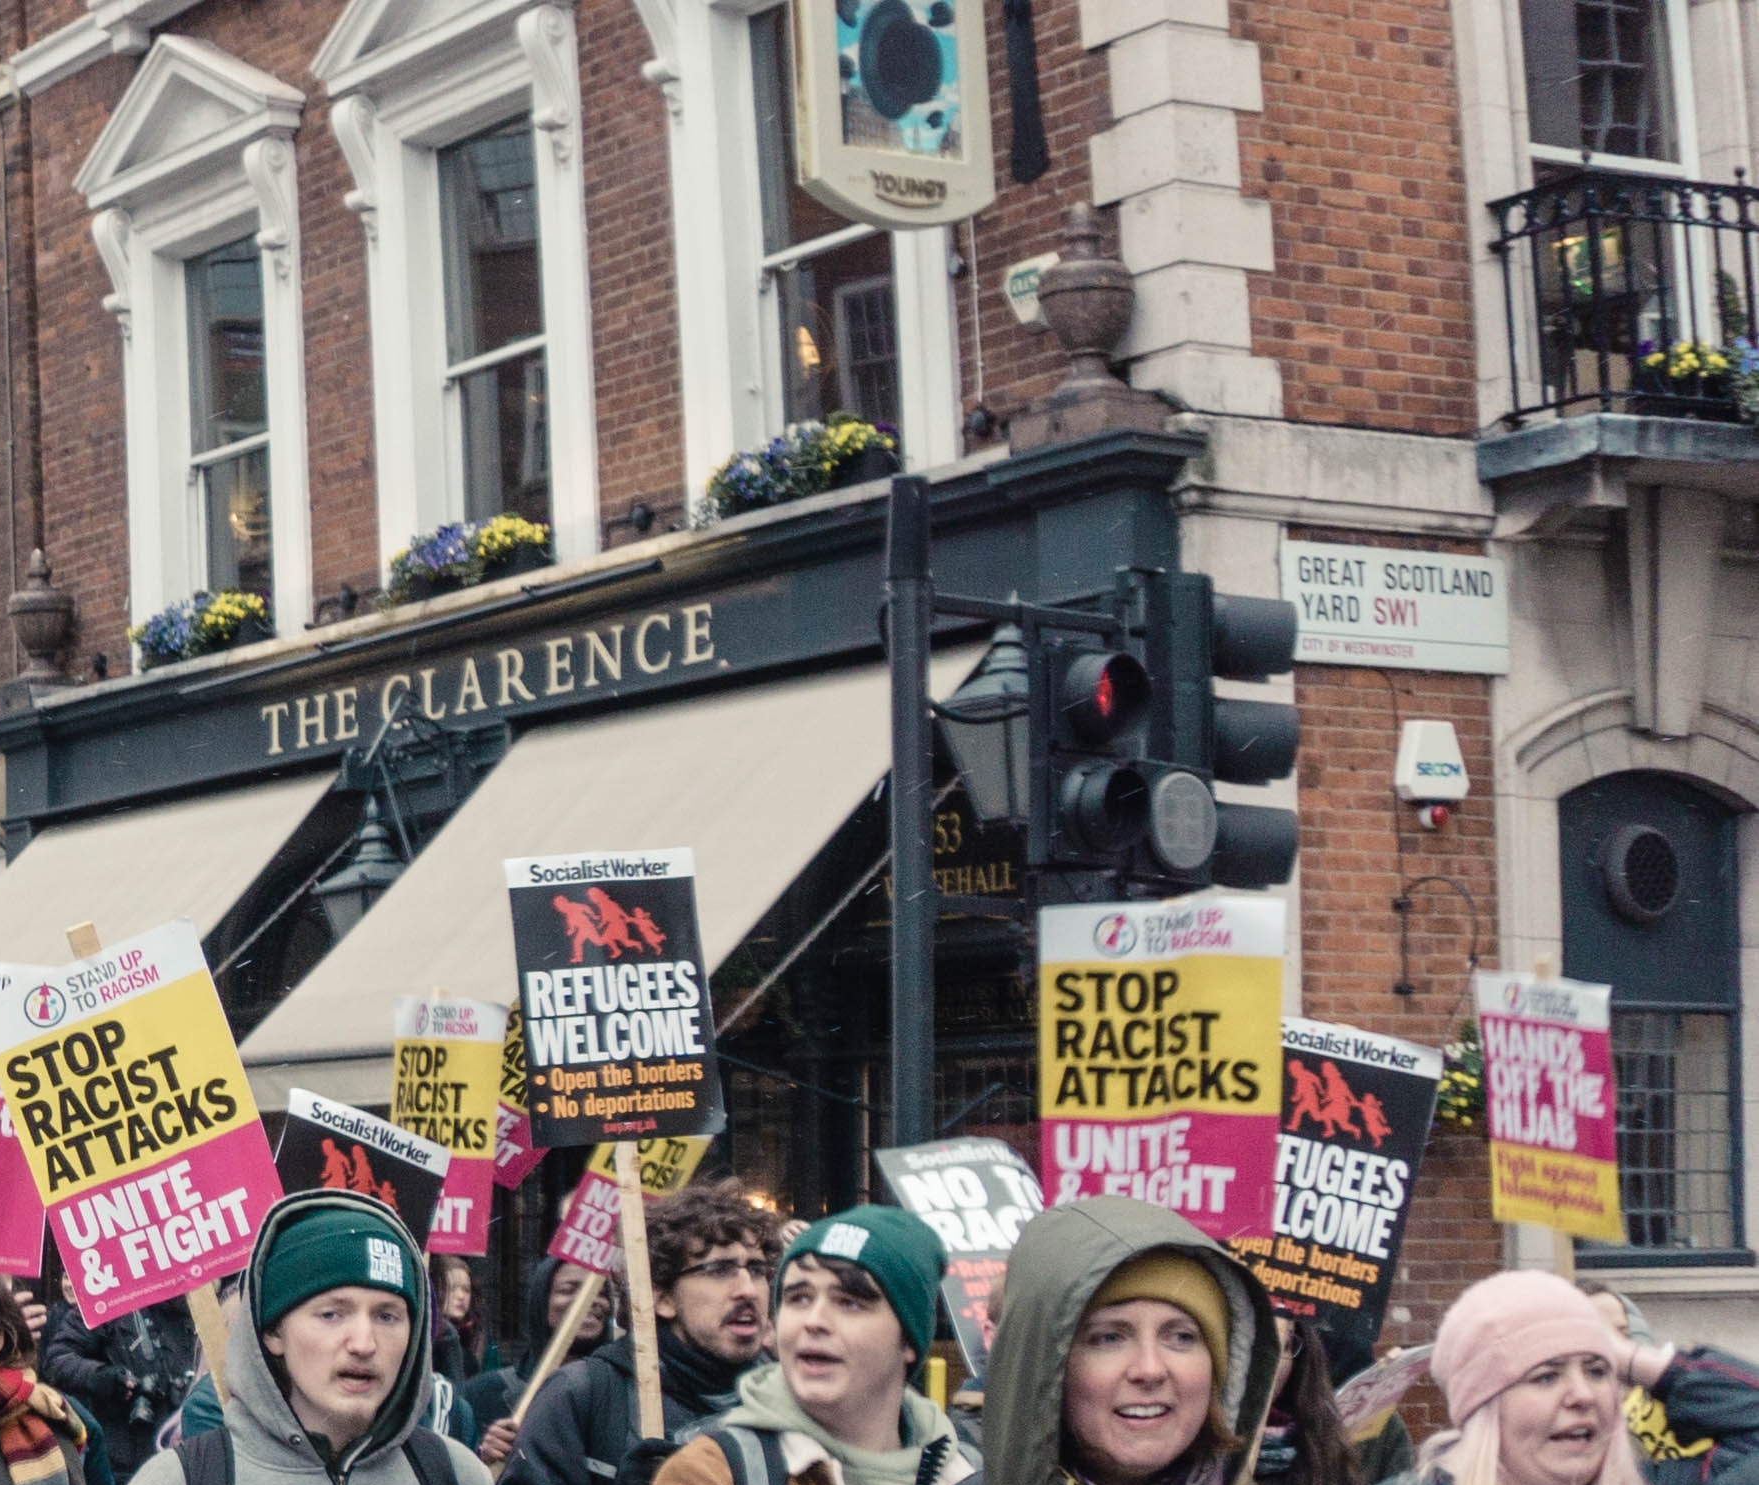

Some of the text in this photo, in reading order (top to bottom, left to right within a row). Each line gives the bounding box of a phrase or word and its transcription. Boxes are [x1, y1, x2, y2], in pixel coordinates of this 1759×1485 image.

[1298, 556, 1493, 598] GREAT SCOTLAND
[1301, 593, 1418, 627] YARD SW1
[1302, 638, 1415, 658] CITY OF WESTMINSTER
[261, 602, 715, 756] THE CLARENCE
[66, 950, 144, 994] STAND UP
[72, 965, 160, 1013] TO RACISM
[527, 960, 701, 1019] REFUGEES
[1054, 969, 1179, 1013] STOP
[6, 1019, 126, 1100] STOP
[528, 1008, 705, 1066] WELCOME
[1054, 1012, 1221, 1060] RACIST
[1484, 1017, 1585, 1070] HANDS
[398, 1045, 447, 1078] STOP
[551, 1061, 704, 1092] Open the borders
[1054, 1058, 1260, 1107] ATTACKS
[20, 1046, 182, 1147] RACIST
[396, 1081, 468, 1114] RACIST
[553, 1088, 696, 1122] No deportations
[1491, 1063, 1606, 1119] OFF THE
[49, 1078, 238, 1193] ATTACKS
[1054, 1117, 1191, 1172] UNITE
[1493, 1099, 1578, 1150] HIJAB
[59, 1159, 201, 1249] UNITE
[899, 1166, 988, 1212] NO
[81, 1248, 122, 1295] &
[119, 1187, 253, 1280] FIGHT
[576, 1204, 613, 1239] TO
[1277, 1238, 1379, 1283] the borders
